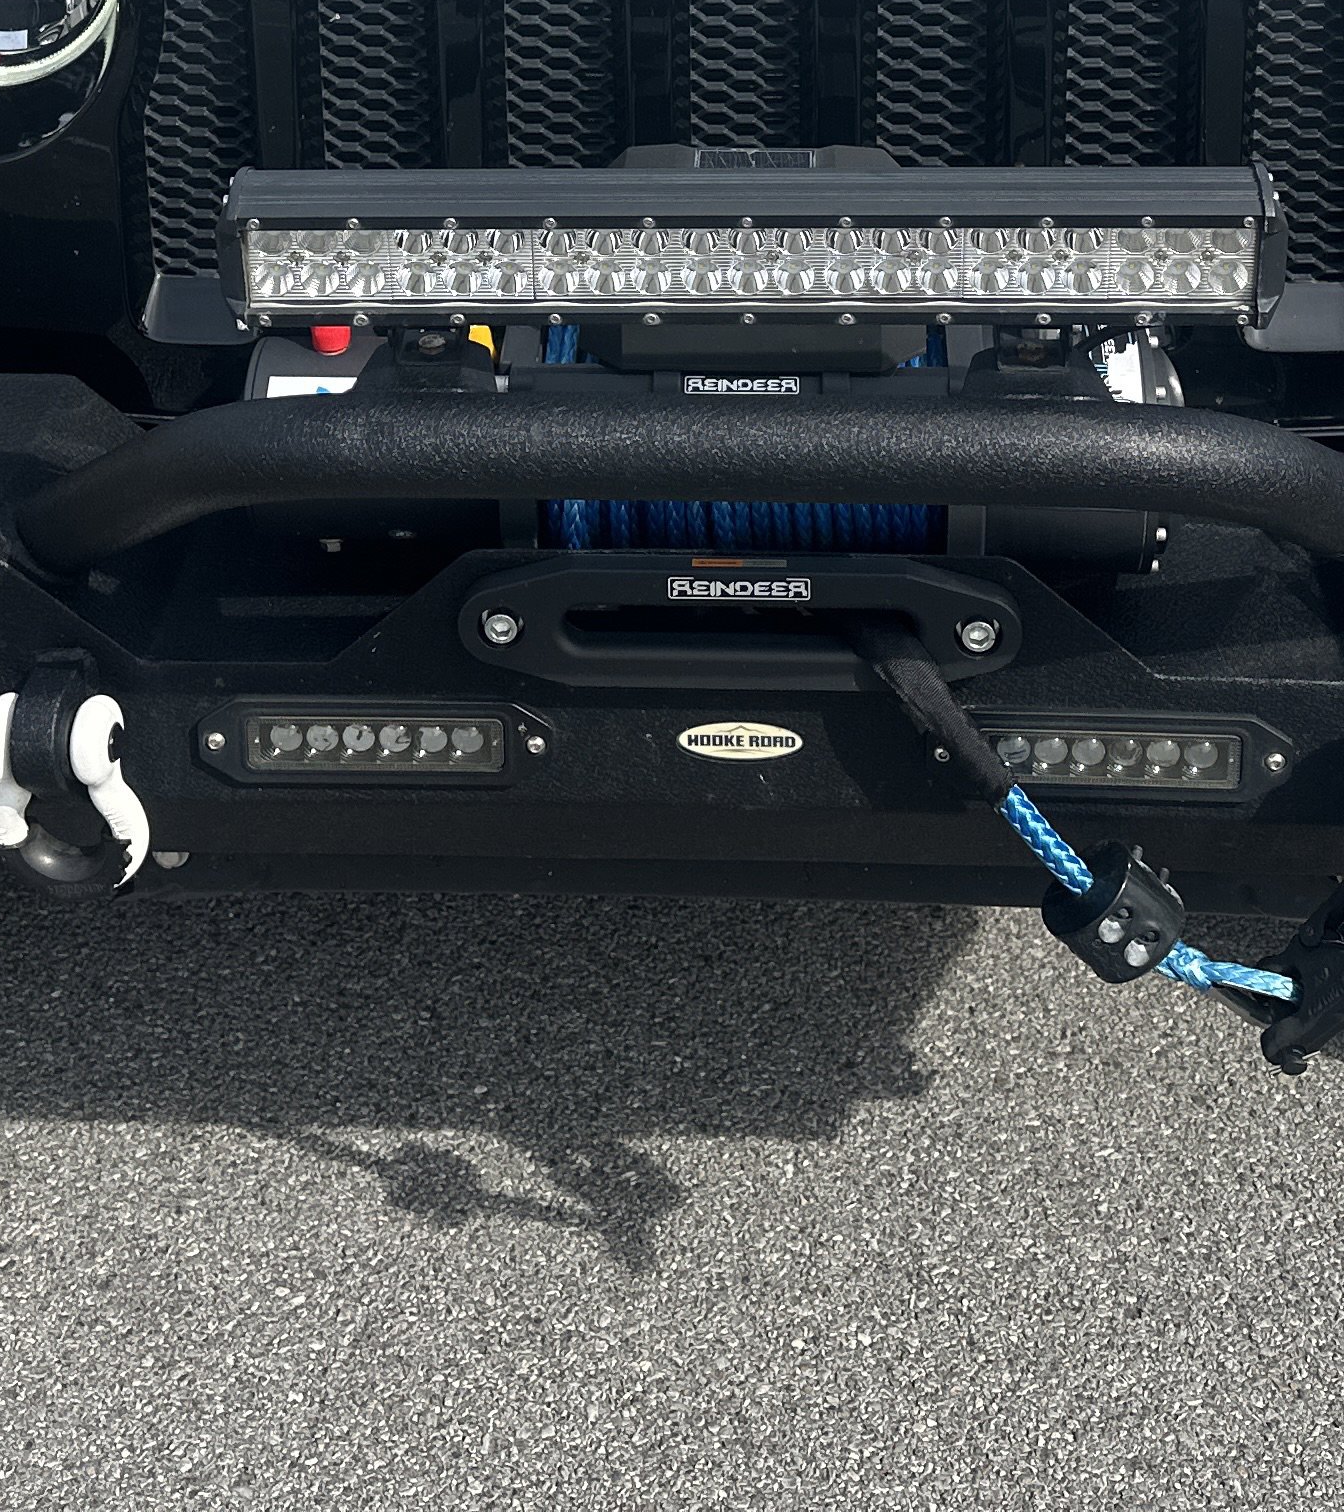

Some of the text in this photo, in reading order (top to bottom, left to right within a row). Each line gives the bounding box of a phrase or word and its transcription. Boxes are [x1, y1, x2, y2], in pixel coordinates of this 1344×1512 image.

[687, 378, 797, 392] REINDEER
[672, 581, 808, 597] REINDEER
[687, 734, 796, 748] HOOKE ROAD
